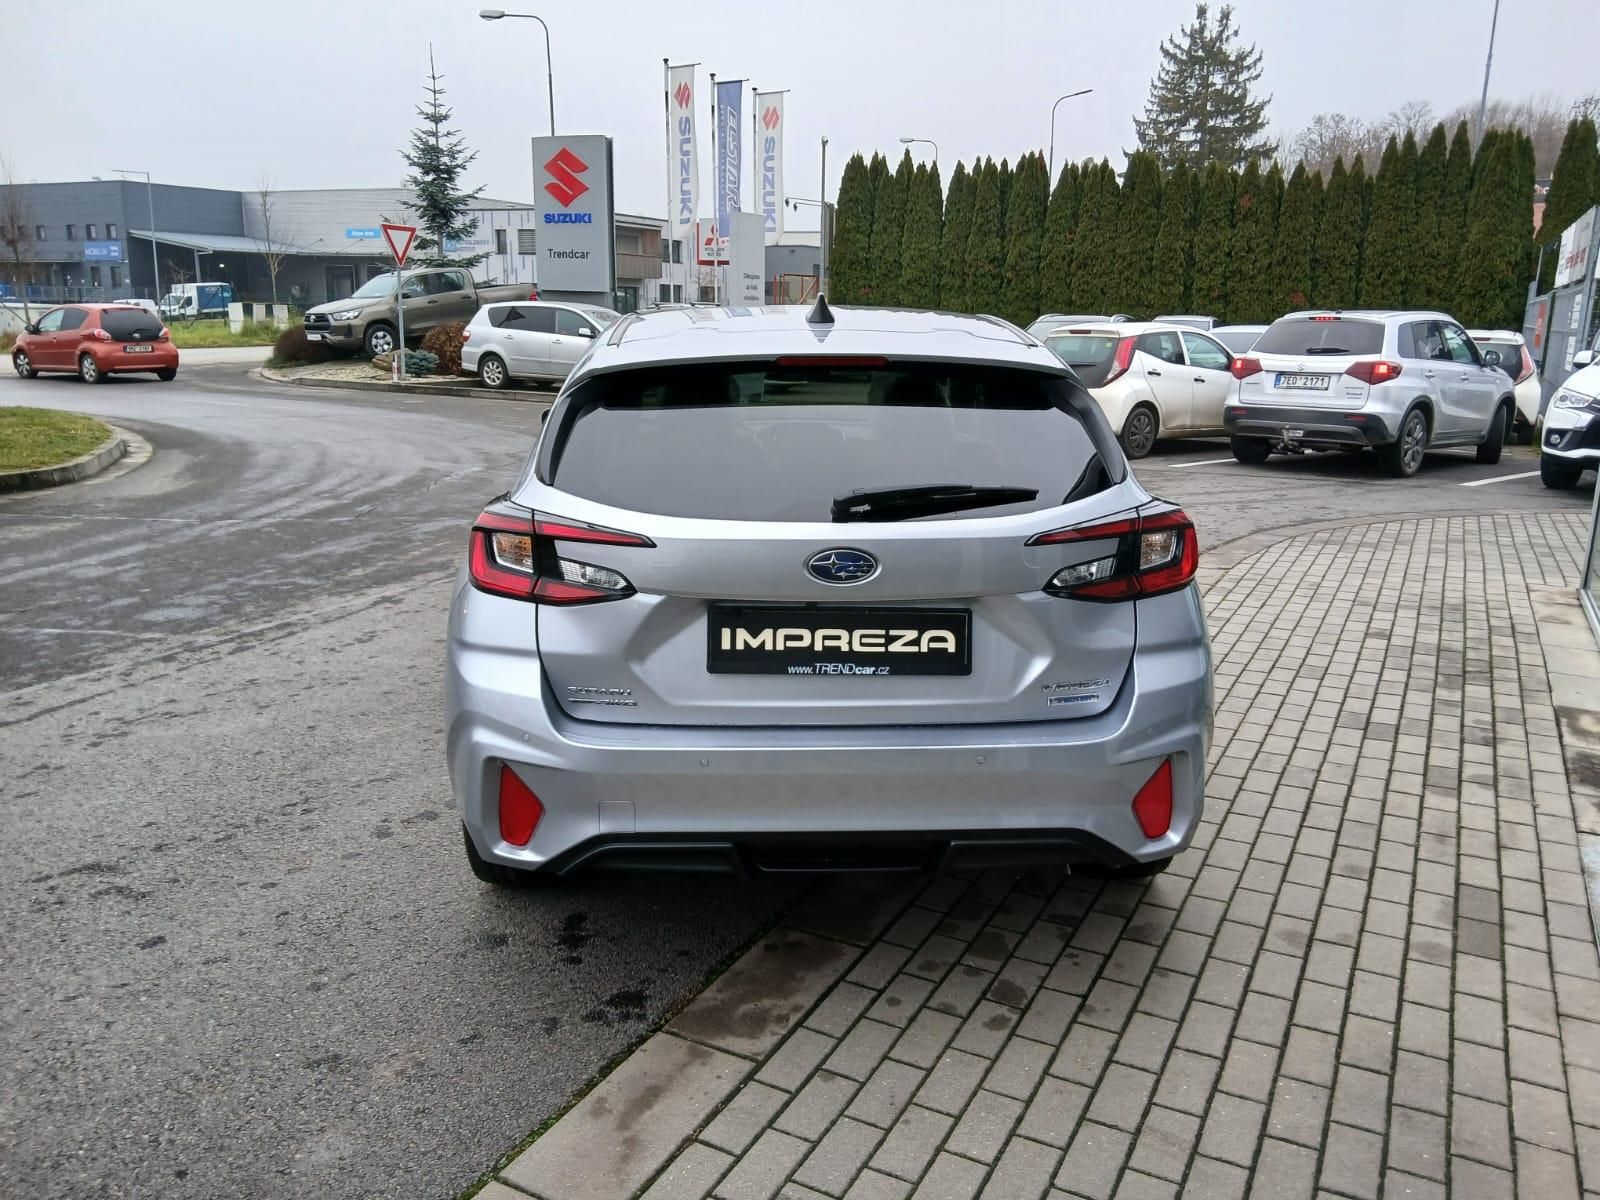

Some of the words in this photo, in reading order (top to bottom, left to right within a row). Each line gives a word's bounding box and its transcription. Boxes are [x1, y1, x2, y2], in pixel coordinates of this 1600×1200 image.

[678, 115, 693, 225] SUZUKI
[762, 135, 777, 233] SUZUKI
[543, 212, 593, 225] SUZUKI
[547, 247, 591, 260] Trendcar
[1303, 376, 1325, 387] 2171
[720, 627, 957, 654] IMPREZA
[787, 662, 890, 675] www.TRENDcar.cz
[567, 686, 632, 696] SUBARU
